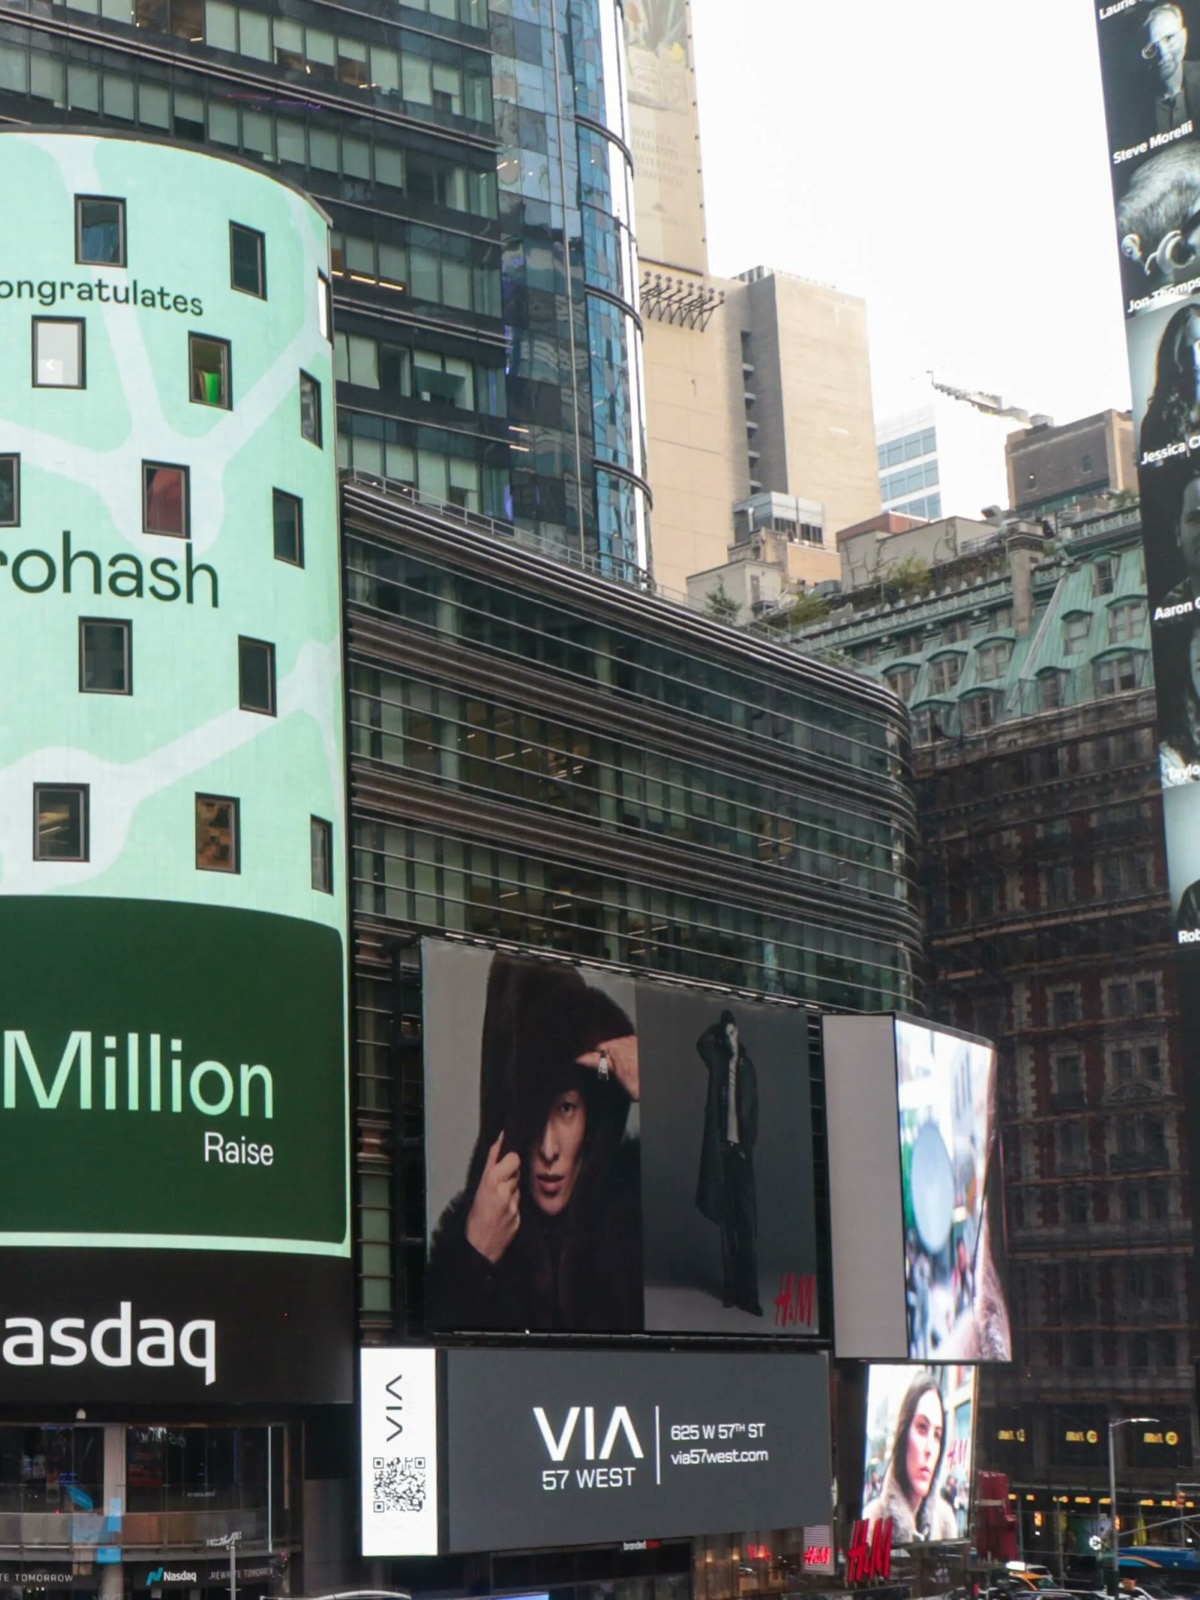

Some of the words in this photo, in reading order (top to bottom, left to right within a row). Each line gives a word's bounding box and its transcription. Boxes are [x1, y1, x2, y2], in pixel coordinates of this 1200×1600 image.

[1113, 141, 1148, 164] Steve
[1149, 120, 1193, 149] Morelli
[1127, 297, 1151, 313] Jon
[1140, 443, 1186, 465] Jessica
[1154, 600, 1193, 621] Aaron
[3, 1029, 274, 1119] Million
[203, 1132, 274, 1166] Raise
[533, 1406, 644, 1461] VIA
[671, 1425, 700, 1440] 625
[702, 1424, 716, 1439] W
[748, 1423, 766, 1438] ST
[671, 1449, 769, 1465] via57west.com
[542, 1470, 570, 1490] 57
[576, 1467, 636, 1489] WEST
[804, 1547, 831, 1566] H&M
[15, 1573, 74, 1583] TOMORROW
[163, 1571, 197, 1583] Nasdaq
